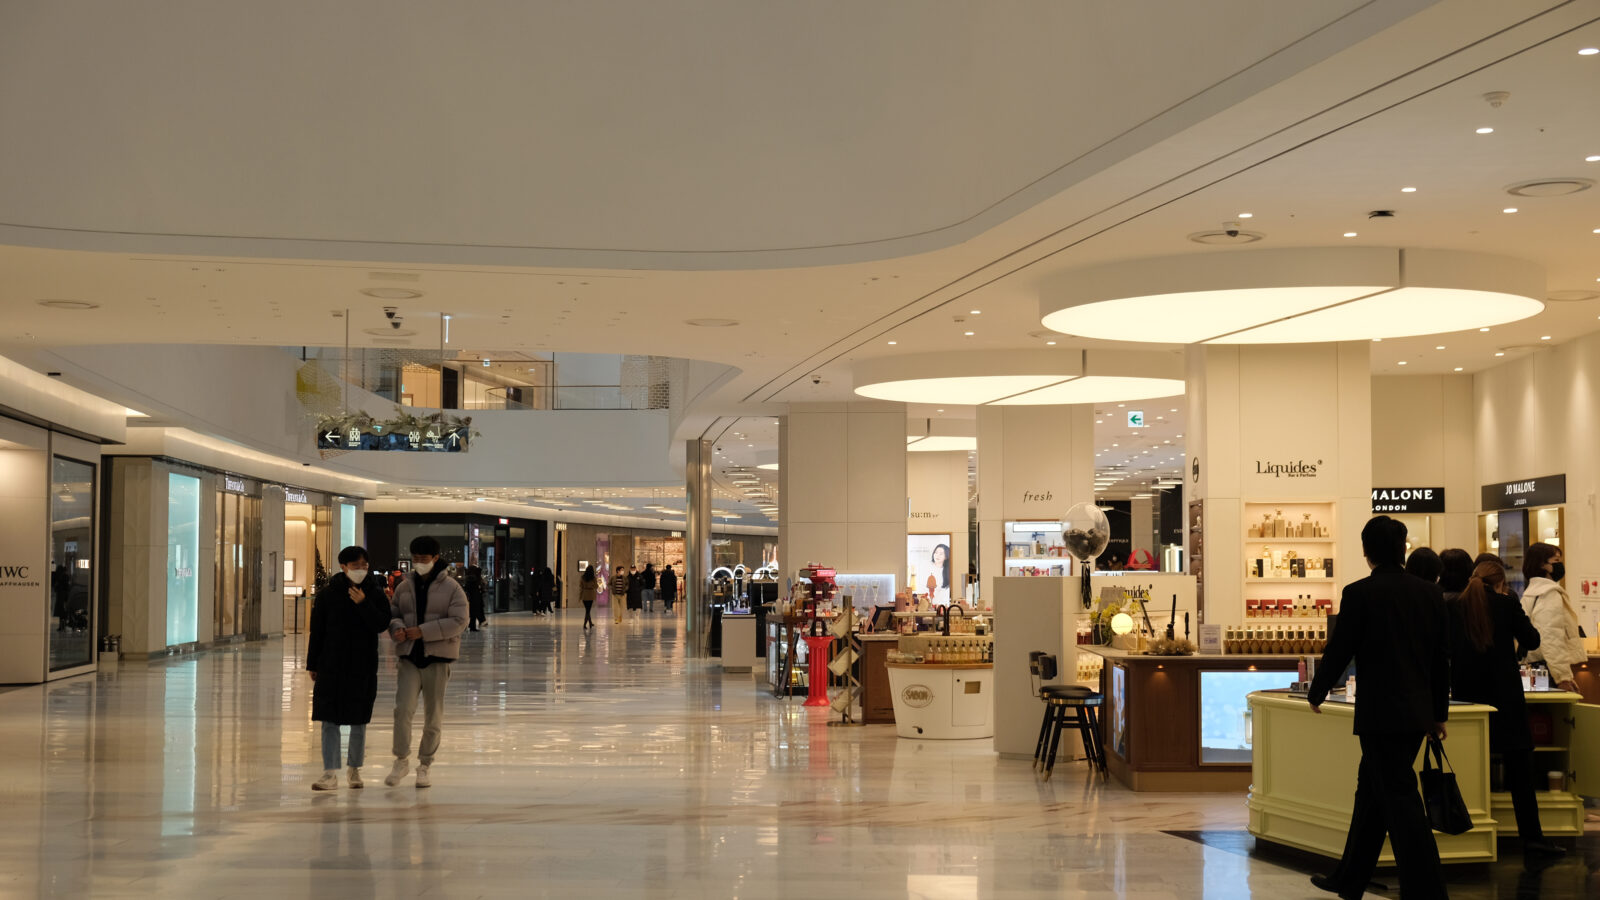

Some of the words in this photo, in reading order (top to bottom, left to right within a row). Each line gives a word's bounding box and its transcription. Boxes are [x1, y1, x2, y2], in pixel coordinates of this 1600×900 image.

[1256, 460, 1317, 478] Liquides
[1505, 484, 1513, 495] JO
[1512, 481, 1536, 494] MALONE
[1023, 490, 1053, 503] fresh
